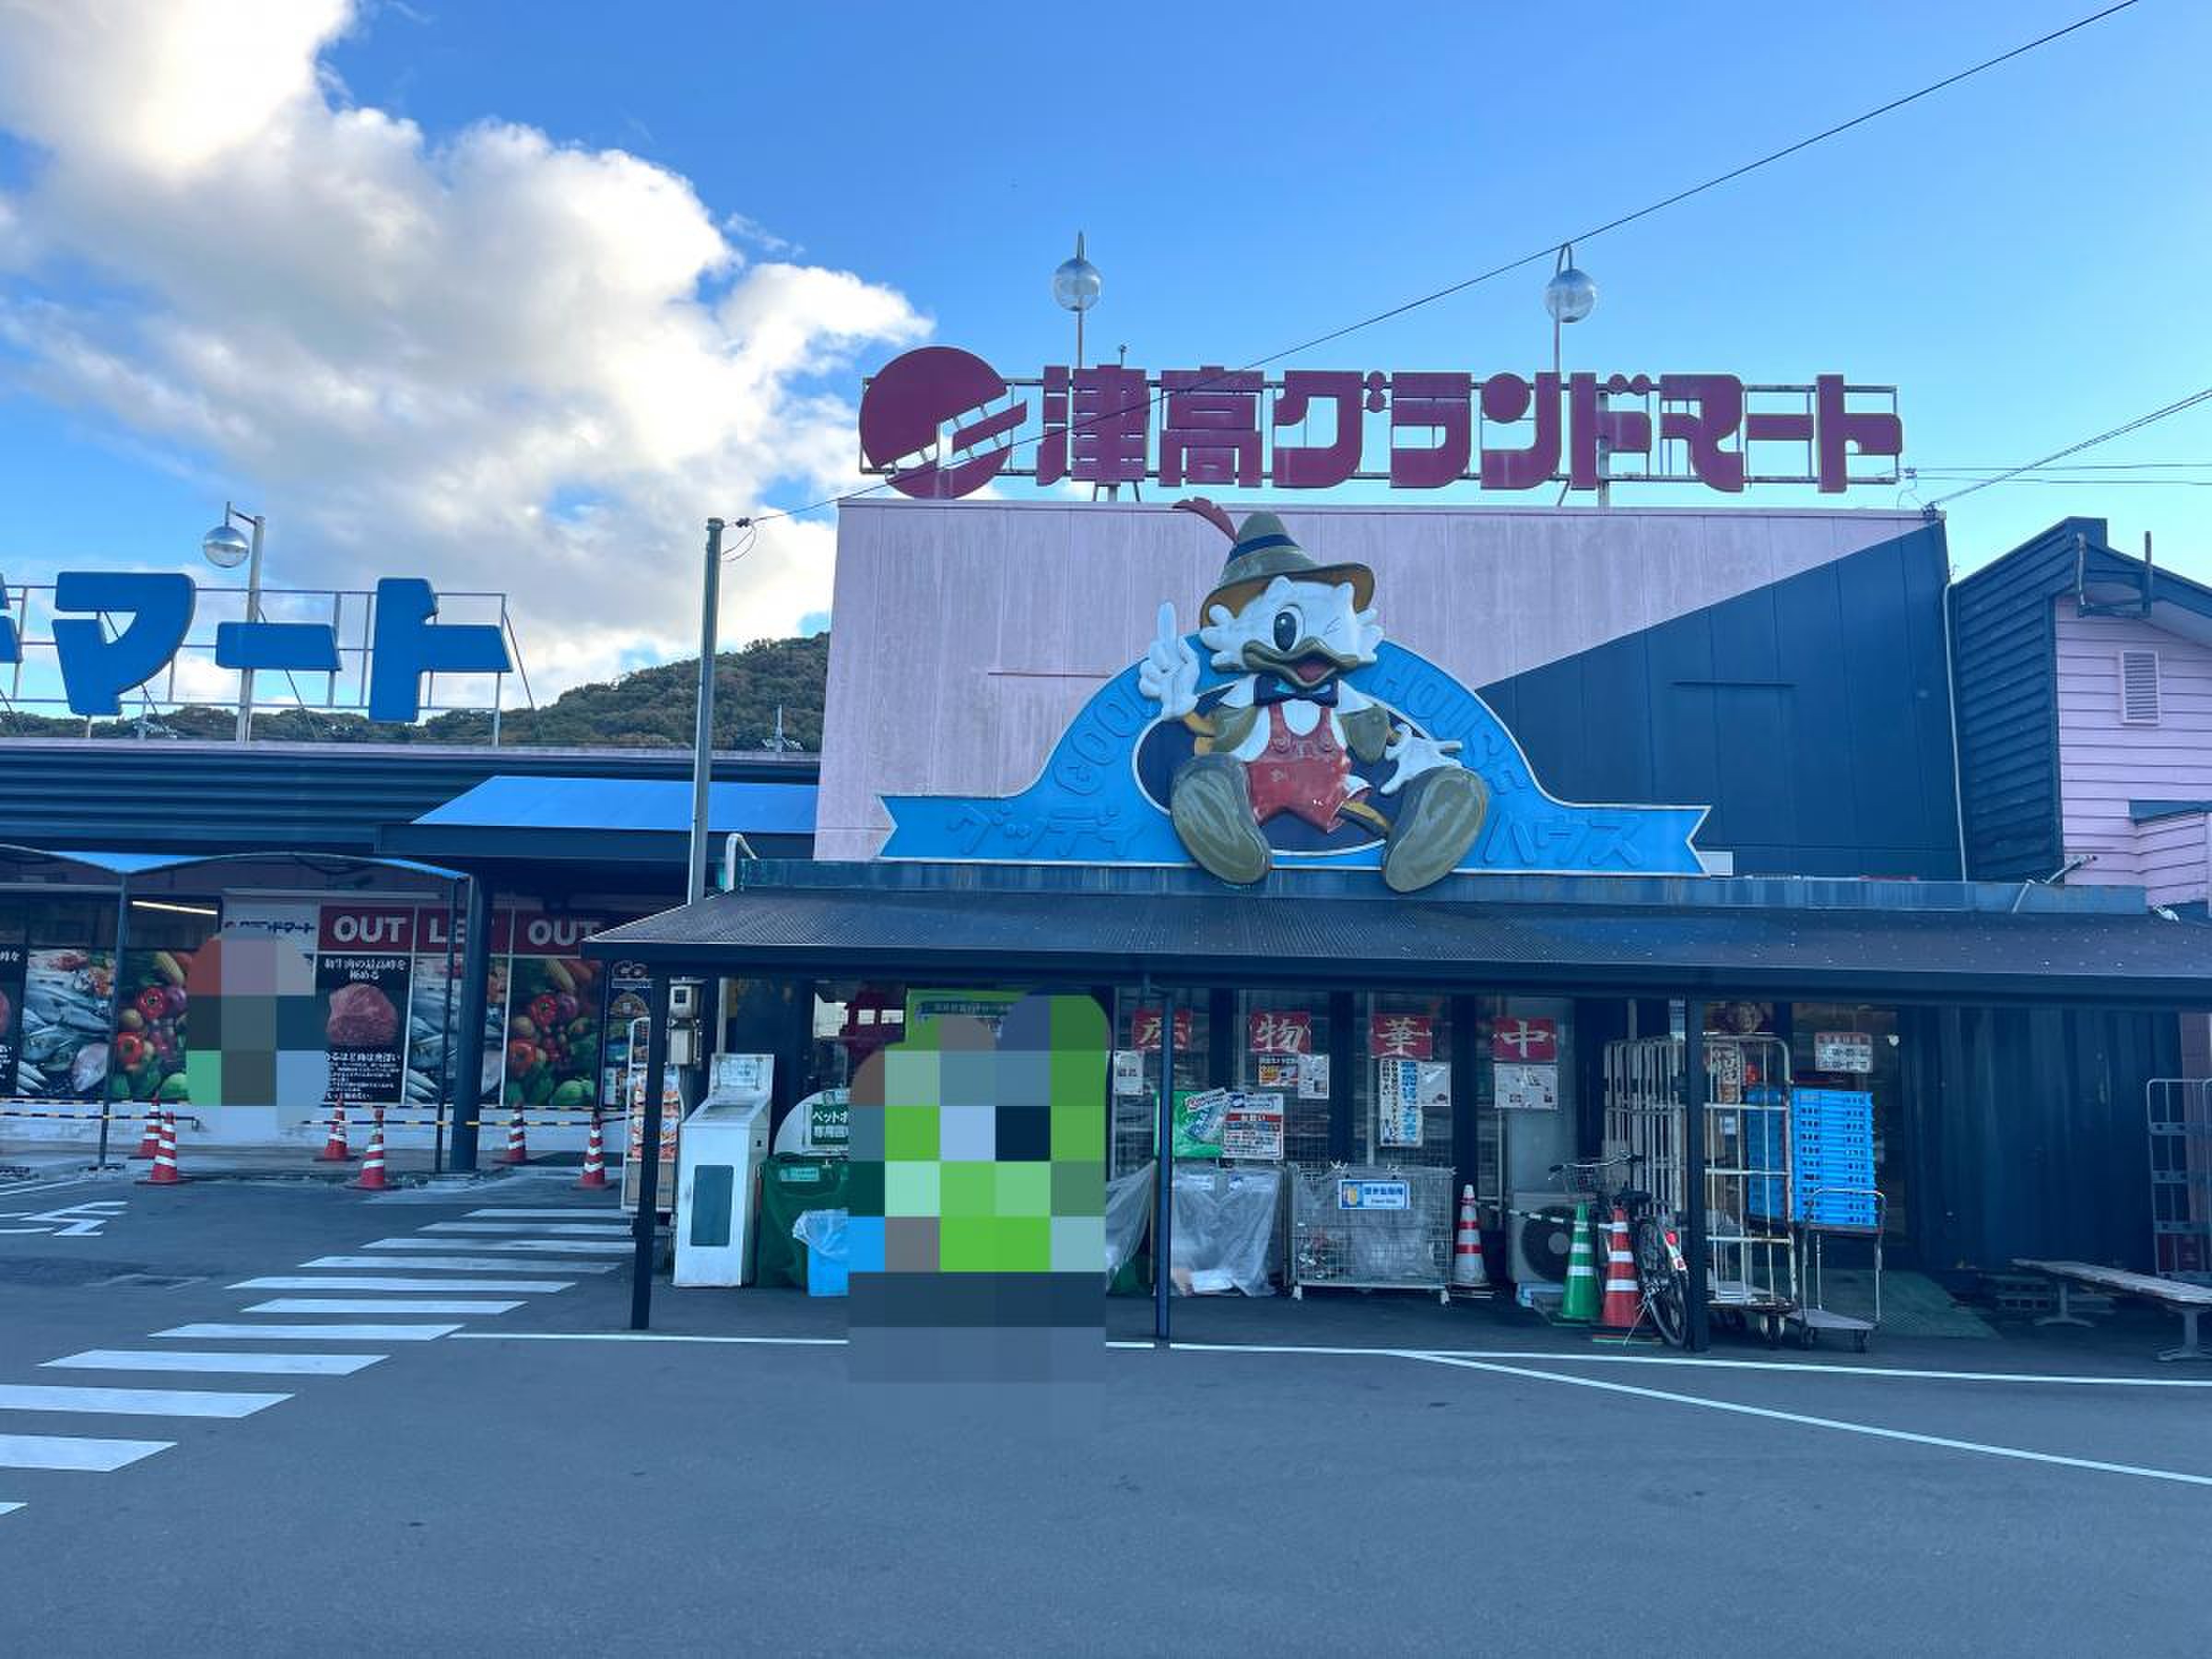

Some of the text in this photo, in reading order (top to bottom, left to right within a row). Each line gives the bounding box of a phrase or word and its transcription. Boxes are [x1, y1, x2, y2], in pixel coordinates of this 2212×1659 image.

[1036, 364, 1904, 494] 津高グランドマート
[0, 571, 513, 724] マート
[1483, 811, 1645, 867] ハウス
[334, 914, 407, 943] OUT
[1253, 1014, 1307, 1053] 物
[1377, 1017, 1430, 1057] 華
[1501, 1020, 1550, 1058] 中
